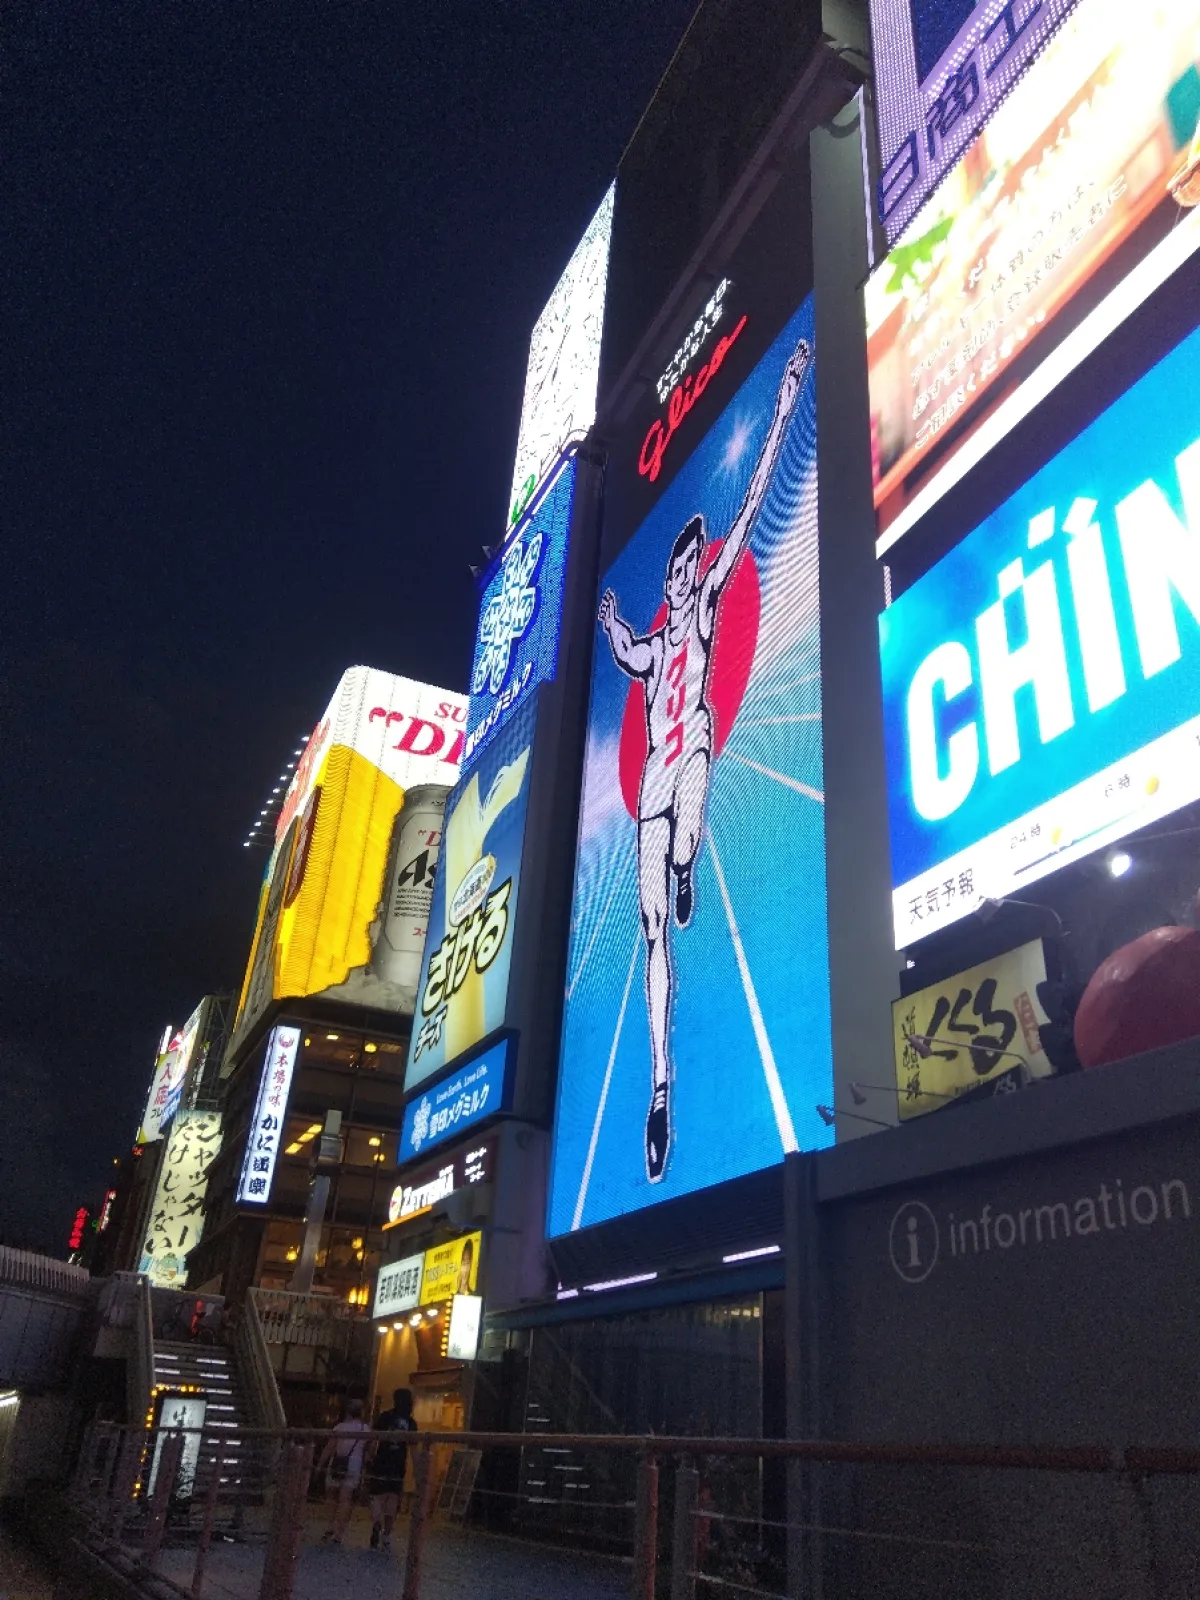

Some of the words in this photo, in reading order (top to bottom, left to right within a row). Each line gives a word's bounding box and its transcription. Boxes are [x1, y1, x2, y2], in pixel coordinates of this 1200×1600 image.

[465, 660, 533, 760] 印メグミルク
[665, 636, 691, 767] グリコ
[421, 875, 513, 1018] さける
[907, 867, 976, 926] 天気予報
[268, 1053, 289, 1108] 本場の味
[178, 1113, 224, 1248] シャッター
[949, 1178, 1191, 1256] information
